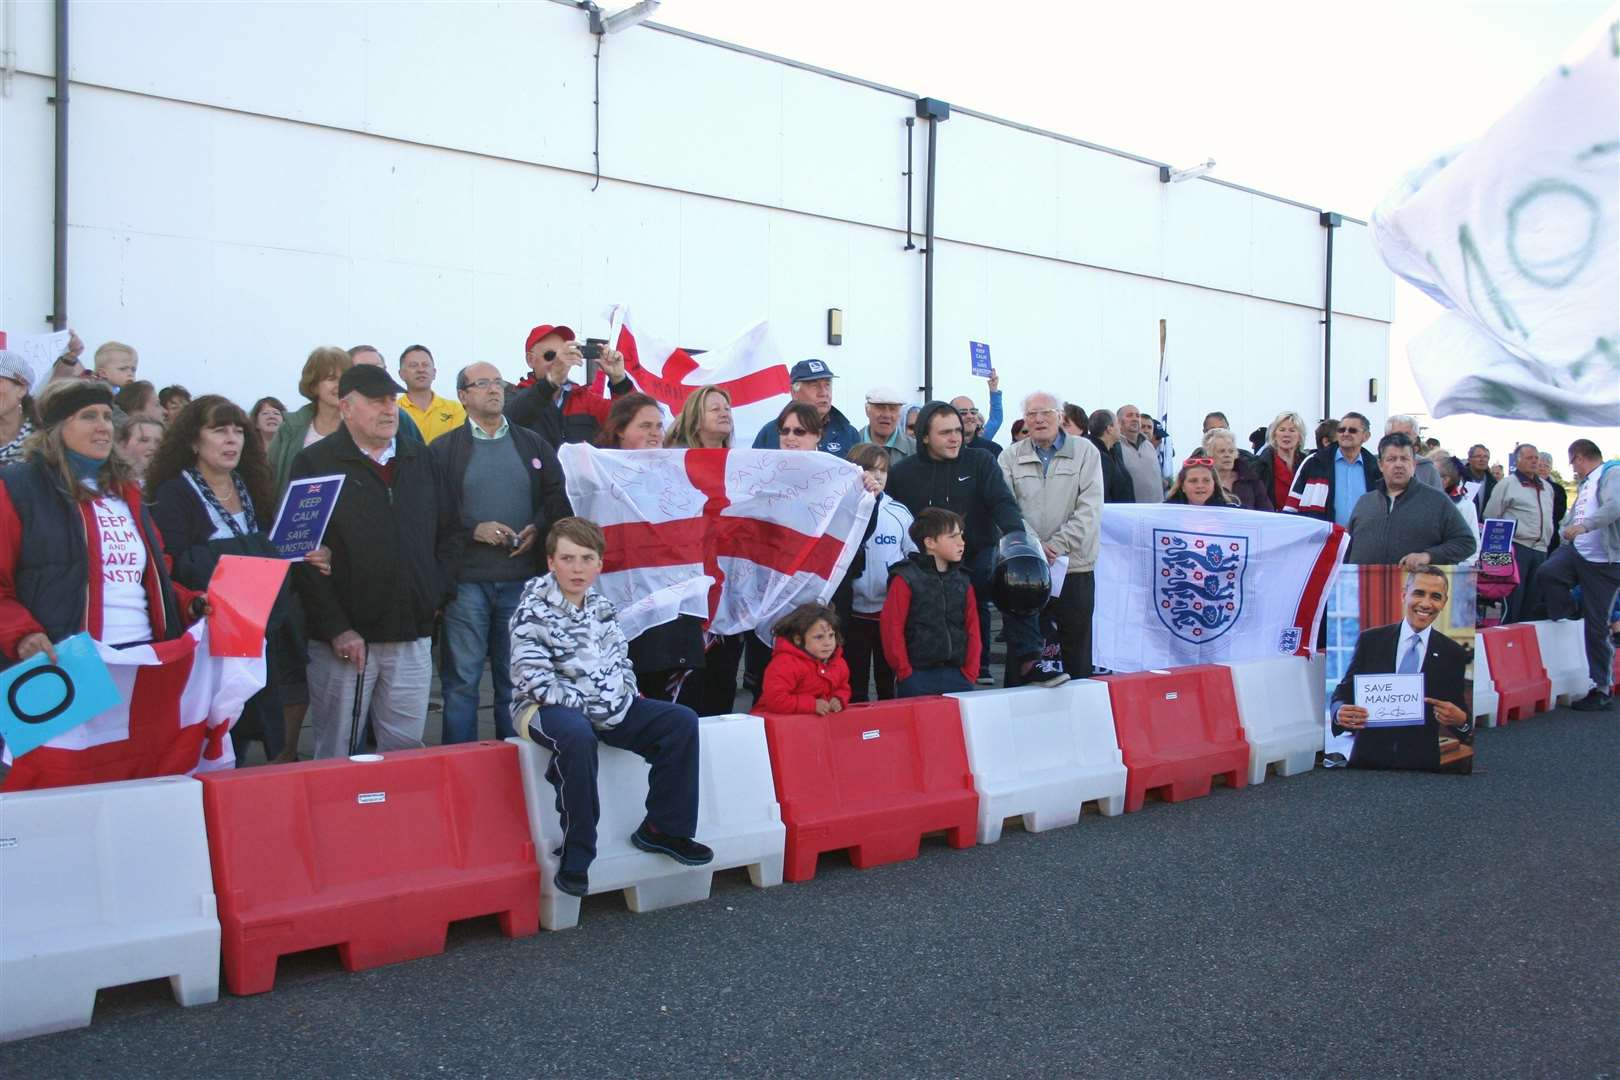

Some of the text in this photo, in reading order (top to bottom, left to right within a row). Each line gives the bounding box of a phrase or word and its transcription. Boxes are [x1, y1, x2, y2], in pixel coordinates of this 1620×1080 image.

[298, 496, 322, 509] KEEP
[98, 515, 128, 528] EEP
[292, 510, 320, 522] CALM
[103, 530, 138, 543] ALM
[286, 529, 311, 541] SAVE
[102, 552, 138, 566] AVE
[1364, 683, 1393, 693] SAVE
[1364, 693, 1419, 704] MANSTON
